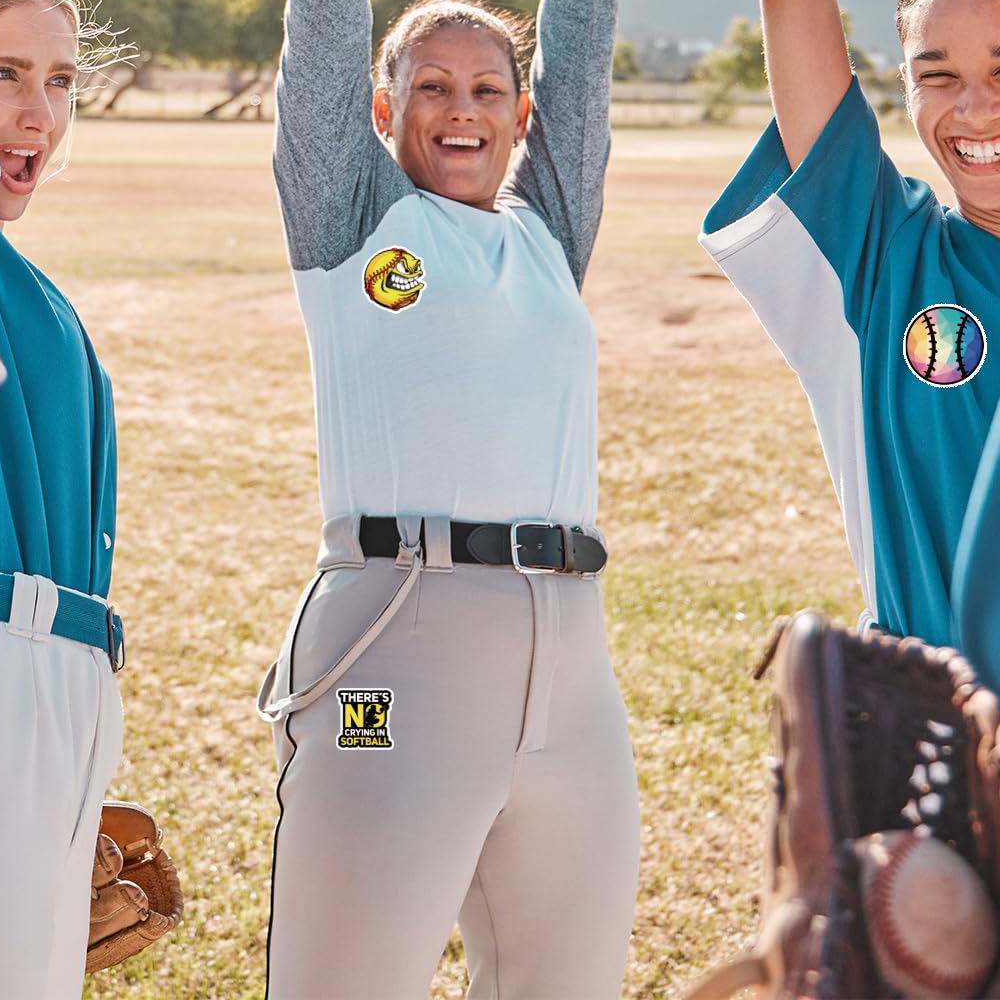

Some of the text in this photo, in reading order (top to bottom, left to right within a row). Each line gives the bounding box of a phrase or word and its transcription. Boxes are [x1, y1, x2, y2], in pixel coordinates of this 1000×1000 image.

[340, 692, 390, 703] THERE'S
[344, 728, 386, 737] CRYING IN
[340, 737, 390, 746] SOFTBALL
